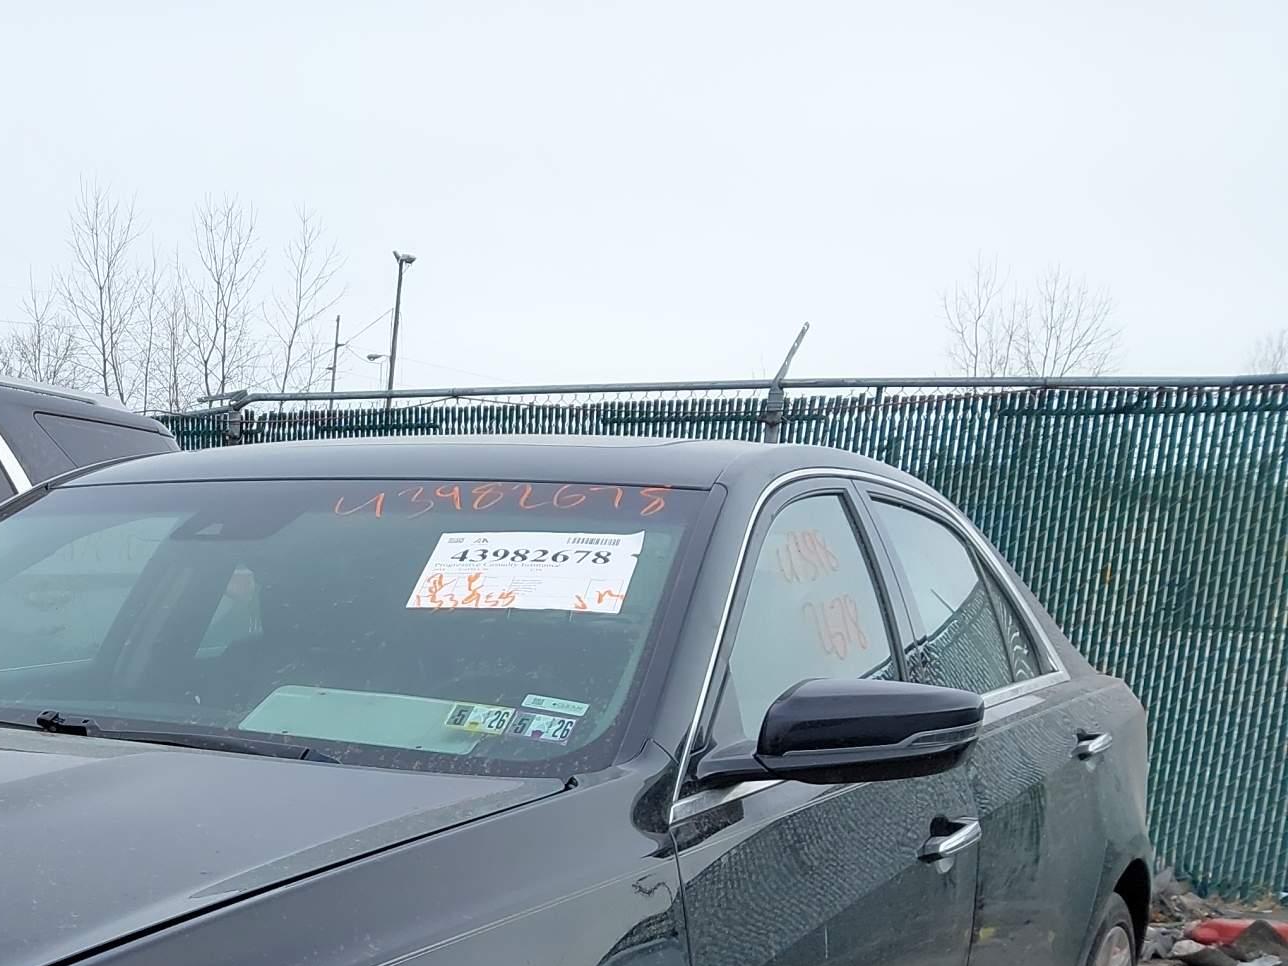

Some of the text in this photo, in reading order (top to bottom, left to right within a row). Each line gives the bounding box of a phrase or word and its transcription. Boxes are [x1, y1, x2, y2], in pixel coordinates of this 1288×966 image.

[334, 483, 673, 518] 43982678
[449, 548, 612, 565] 43982678
[454, 709, 510, 730] 5 26
[514, 718, 574, 739] 5 26
